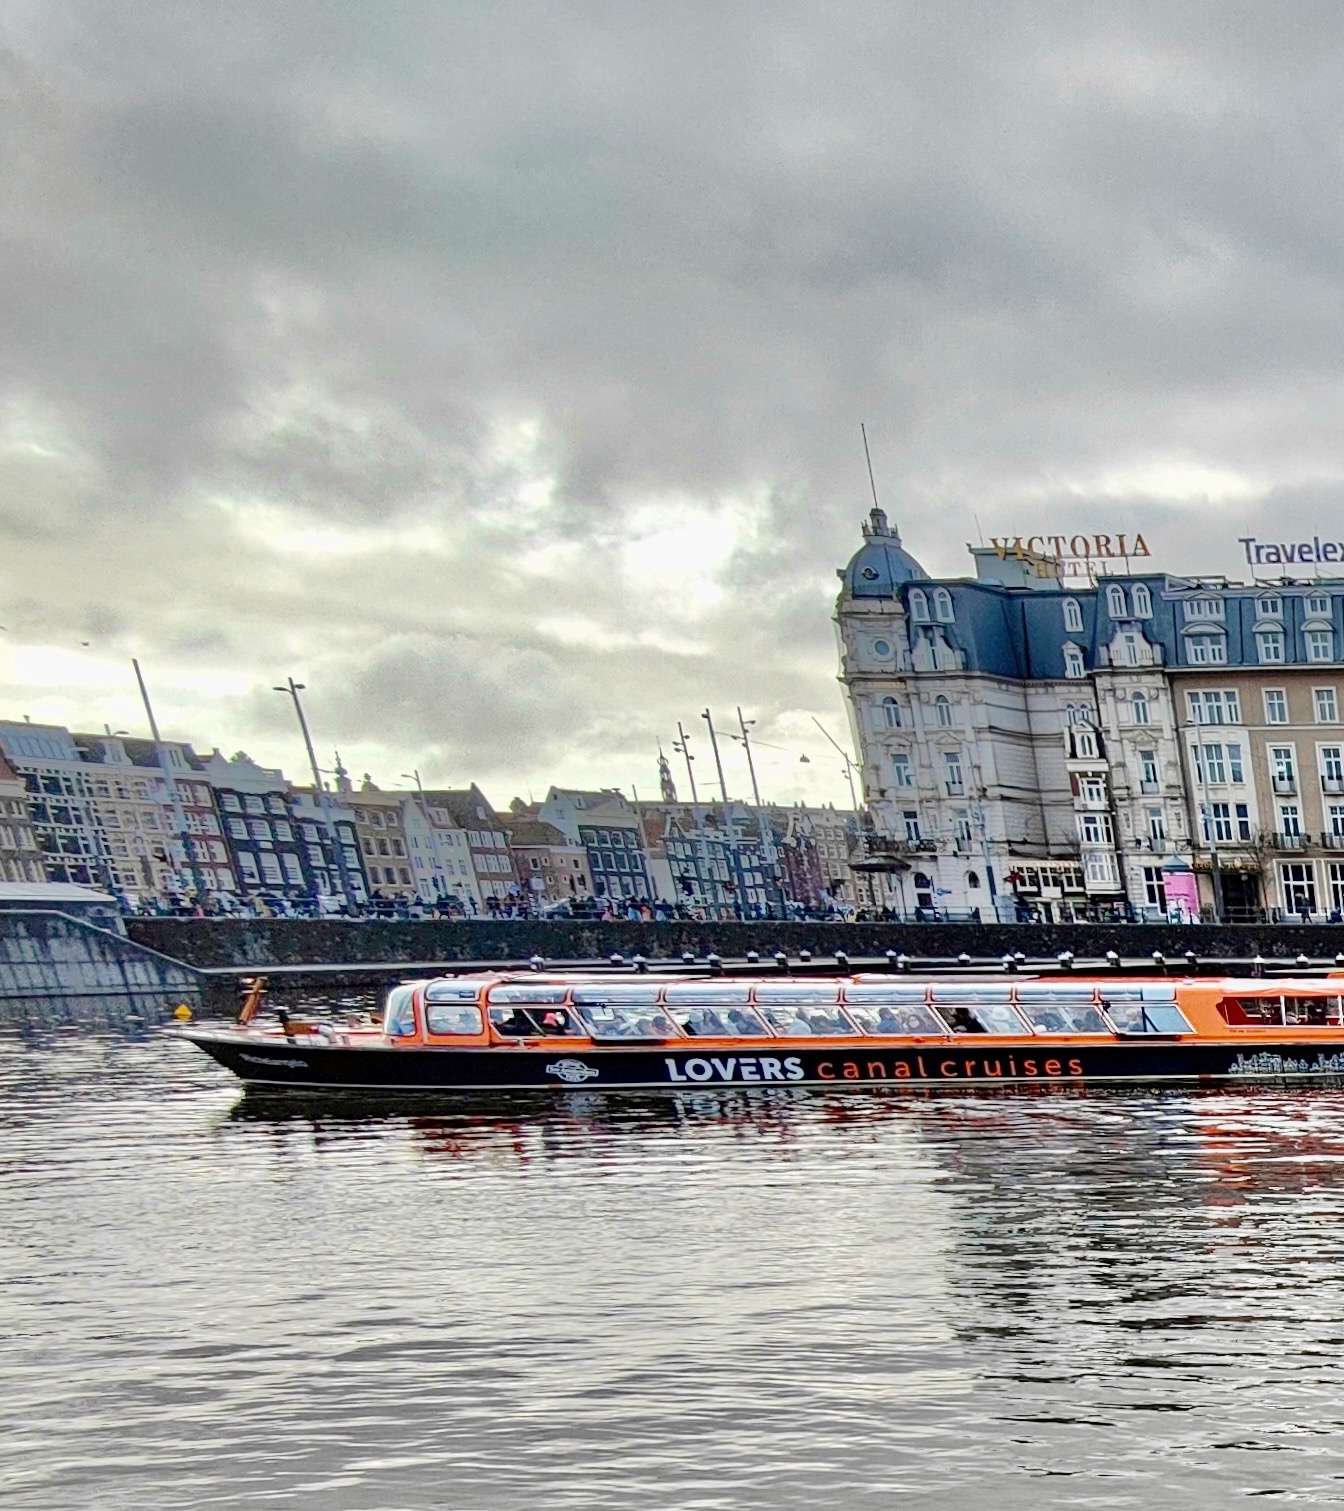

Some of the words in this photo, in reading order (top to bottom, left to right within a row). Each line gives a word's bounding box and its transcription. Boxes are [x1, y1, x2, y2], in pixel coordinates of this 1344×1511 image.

[989, 533, 1152, 560] VICTORIA
[1036, 561, 1114, 577] HOTEL
[665, 1057, 805, 1082] LOVERS
[816, 1055, 929, 1079] canal
[939, 1054, 1084, 1078] cruises
